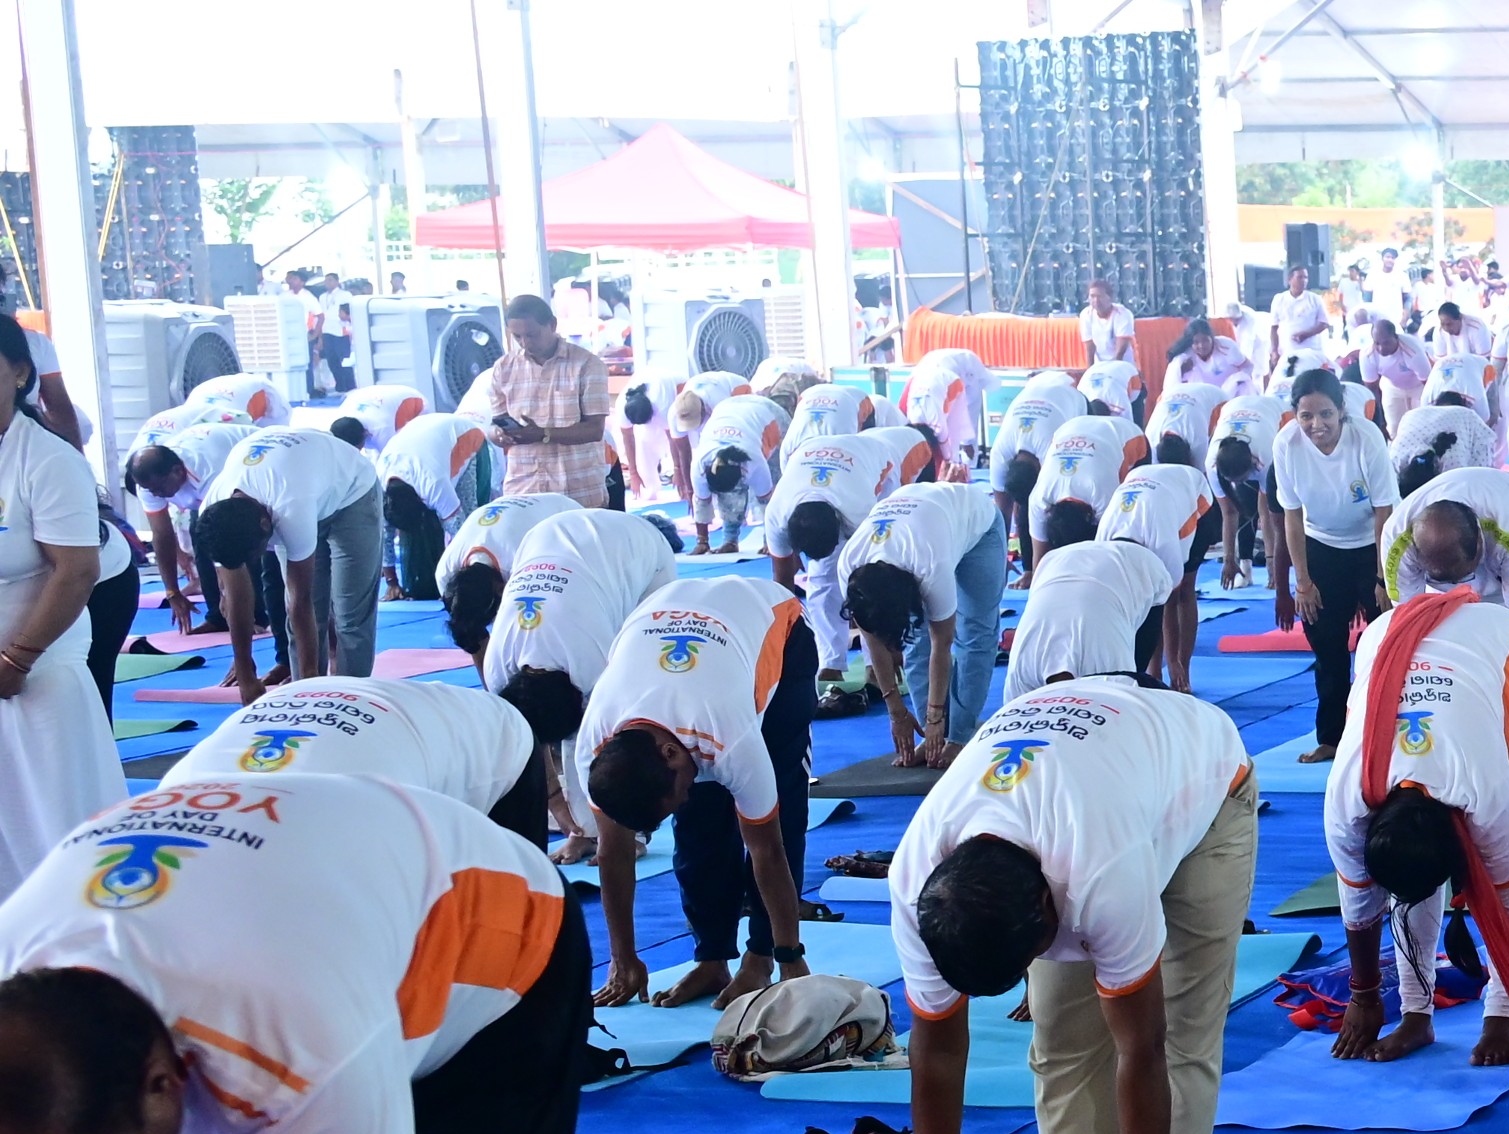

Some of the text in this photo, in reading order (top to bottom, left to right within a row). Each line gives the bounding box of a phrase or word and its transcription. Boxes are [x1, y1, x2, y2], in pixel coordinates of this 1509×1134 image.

[804, 450, 854, 467] YOGA
[667, 619, 707, 629] DAY OF
[642, 626, 728, 648] INTERNATIONAL
[1406, 661, 1432, 672] ୨୦
[1410, 675, 1454, 687] ଯୋଗ
[312, 701, 376, 725] ଯୋଗ
[1045, 705, 1107, 726] ଯୋଗ
[239, 712, 359, 737] ଅନ୍ତର୍ଜାତୀୟ
[119, 810, 220, 824] DAY OF
